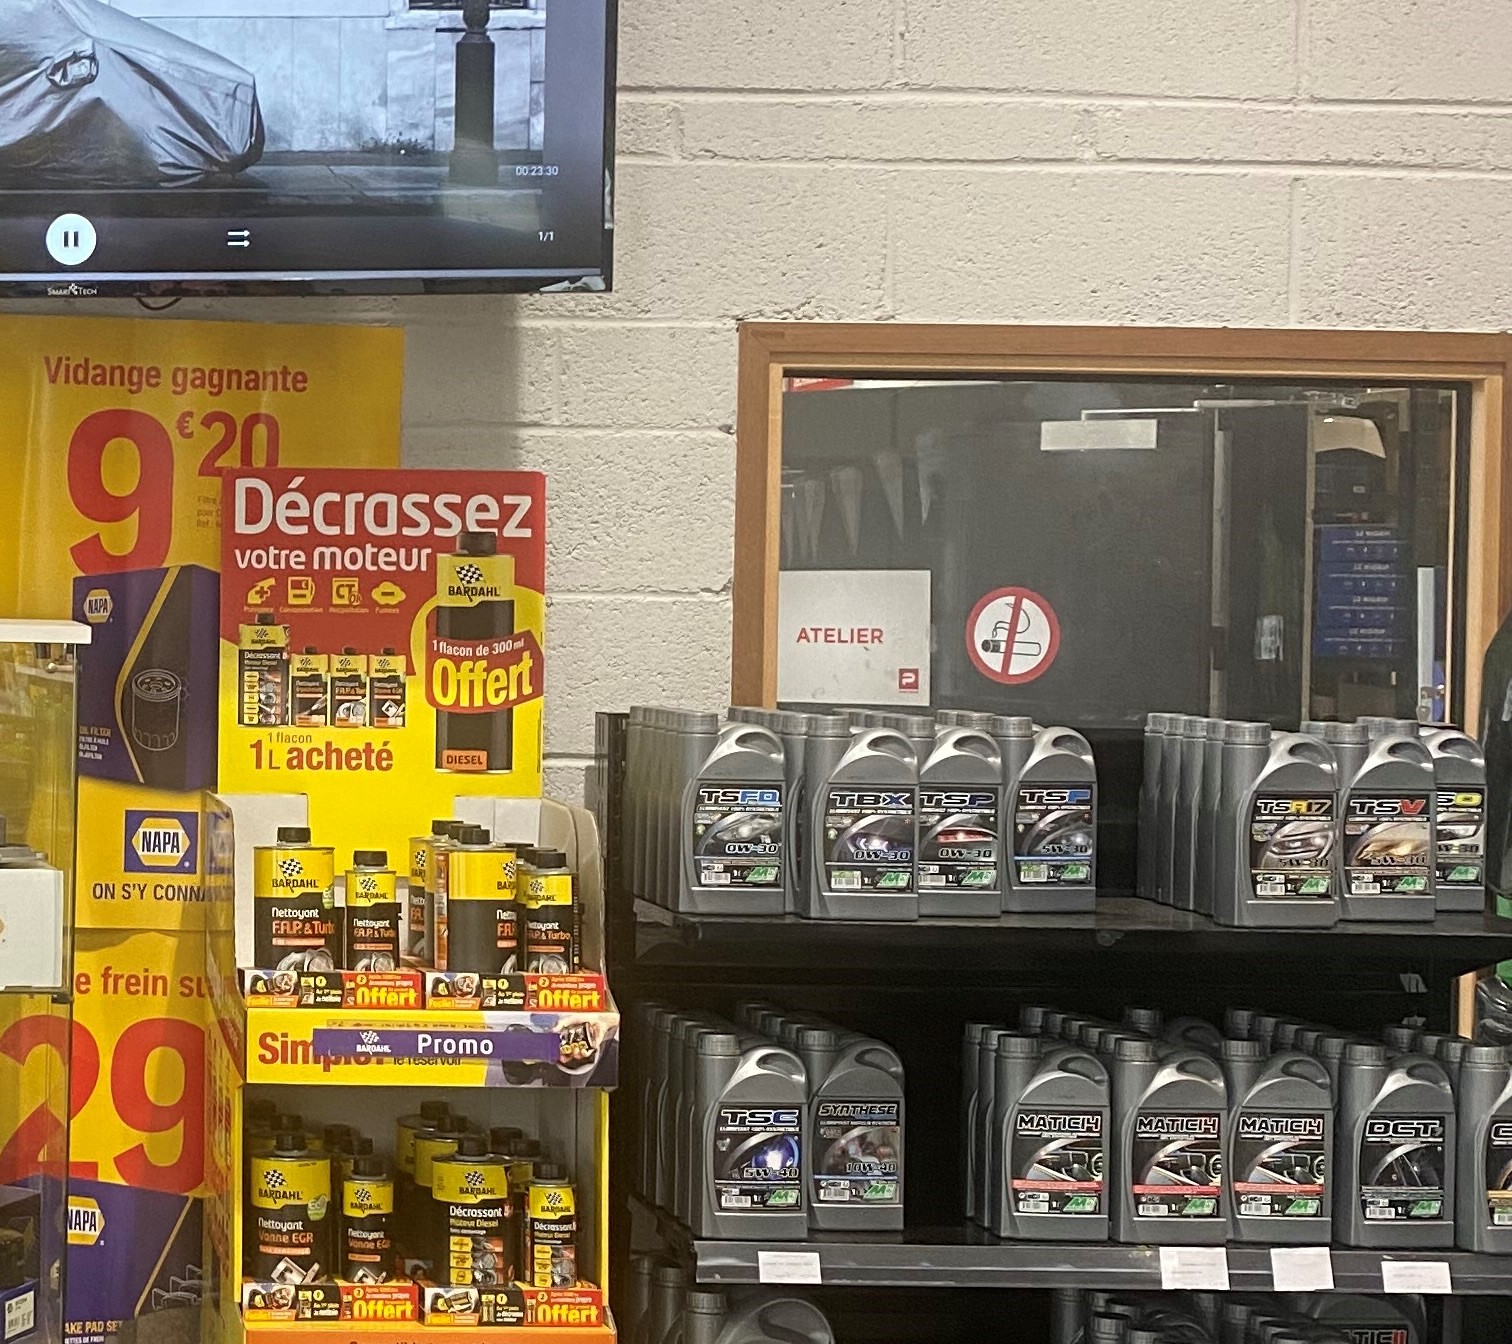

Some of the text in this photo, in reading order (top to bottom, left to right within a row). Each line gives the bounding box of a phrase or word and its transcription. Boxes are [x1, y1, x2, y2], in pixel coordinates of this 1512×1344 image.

[515, 166, 559, 176] 00:23:30
[538, 231, 554, 241] 1/1
[44, 356, 309, 396] Vidange gagnante
[67, 408, 174, 574] 9
[234, 476, 533, 539] Décrassez
[234, 542, 432, 571] votre moteur
[447, 585, 501, 598] BARDAHL
[87, 598, 109, 614] NAPA
[796, 627, 884, 644] ATELIER
[431, 639, 439, 652] 1
[439, 639, 473, 656] flacon
[475, 641, 490, 656] de
[491, 639, 513, 654] 300
[432, 650, 533, 707] Offert
[267, 732, 313, 744] 1 flacon
[249, 739, 263, 770] 1
[286, 740, 394, 772] acheté
[445, 753, 484, 767] DIESEL
[829, 792, 912, 807] TBX
[919, 792, 995, 807] TSP
[1349, 798, 1427, 816] TSV
[141, 831, 181, 854] NAPA
[725, 842, 779, 854] 0W-30
[853, 849, 911, 861] 0W-30
[938, 848, 993, 858] 0W-30
[271, 879, 320, 889] BARDAHL
[93, 883, 206, 903] ON S'Y CONN
[355, 892, 389, 901] BARDAHL
[271, 907, 320, 919] Nettoyant
[353, 918, 390, 929] Nettoyant
[100, 966, 168, 997] frein
[356, 986, 418, 1007] Offert
[539, 989, 601, 1009] Offert
[356, 1034, 494, 1055] BARDAHL Promo
[818, 1103, 898, 1118] SYNTHESE
[1365, 1119, 1441, 1138] DCT
[743, 1167, 800, 1179] 5W-40
[845, 1162, 898, 1173] 10W-40
[258, 1188, 303, 1201] BARDAHL
[458, 1187, 497, 1196] BARDAHL
[449, 1205, 503, 1218] Décrassant
[258, 1217, 304, 1232] Nettoyant
[258, 1232, 314, 1244] Vanne EGR
[353, 1299, 414, 1320] Offert
[538, 1304, 599, 1324] Offert
[64, 1321, 83, 1334] AKE
[85, 1320, 105, 1334] PAD
